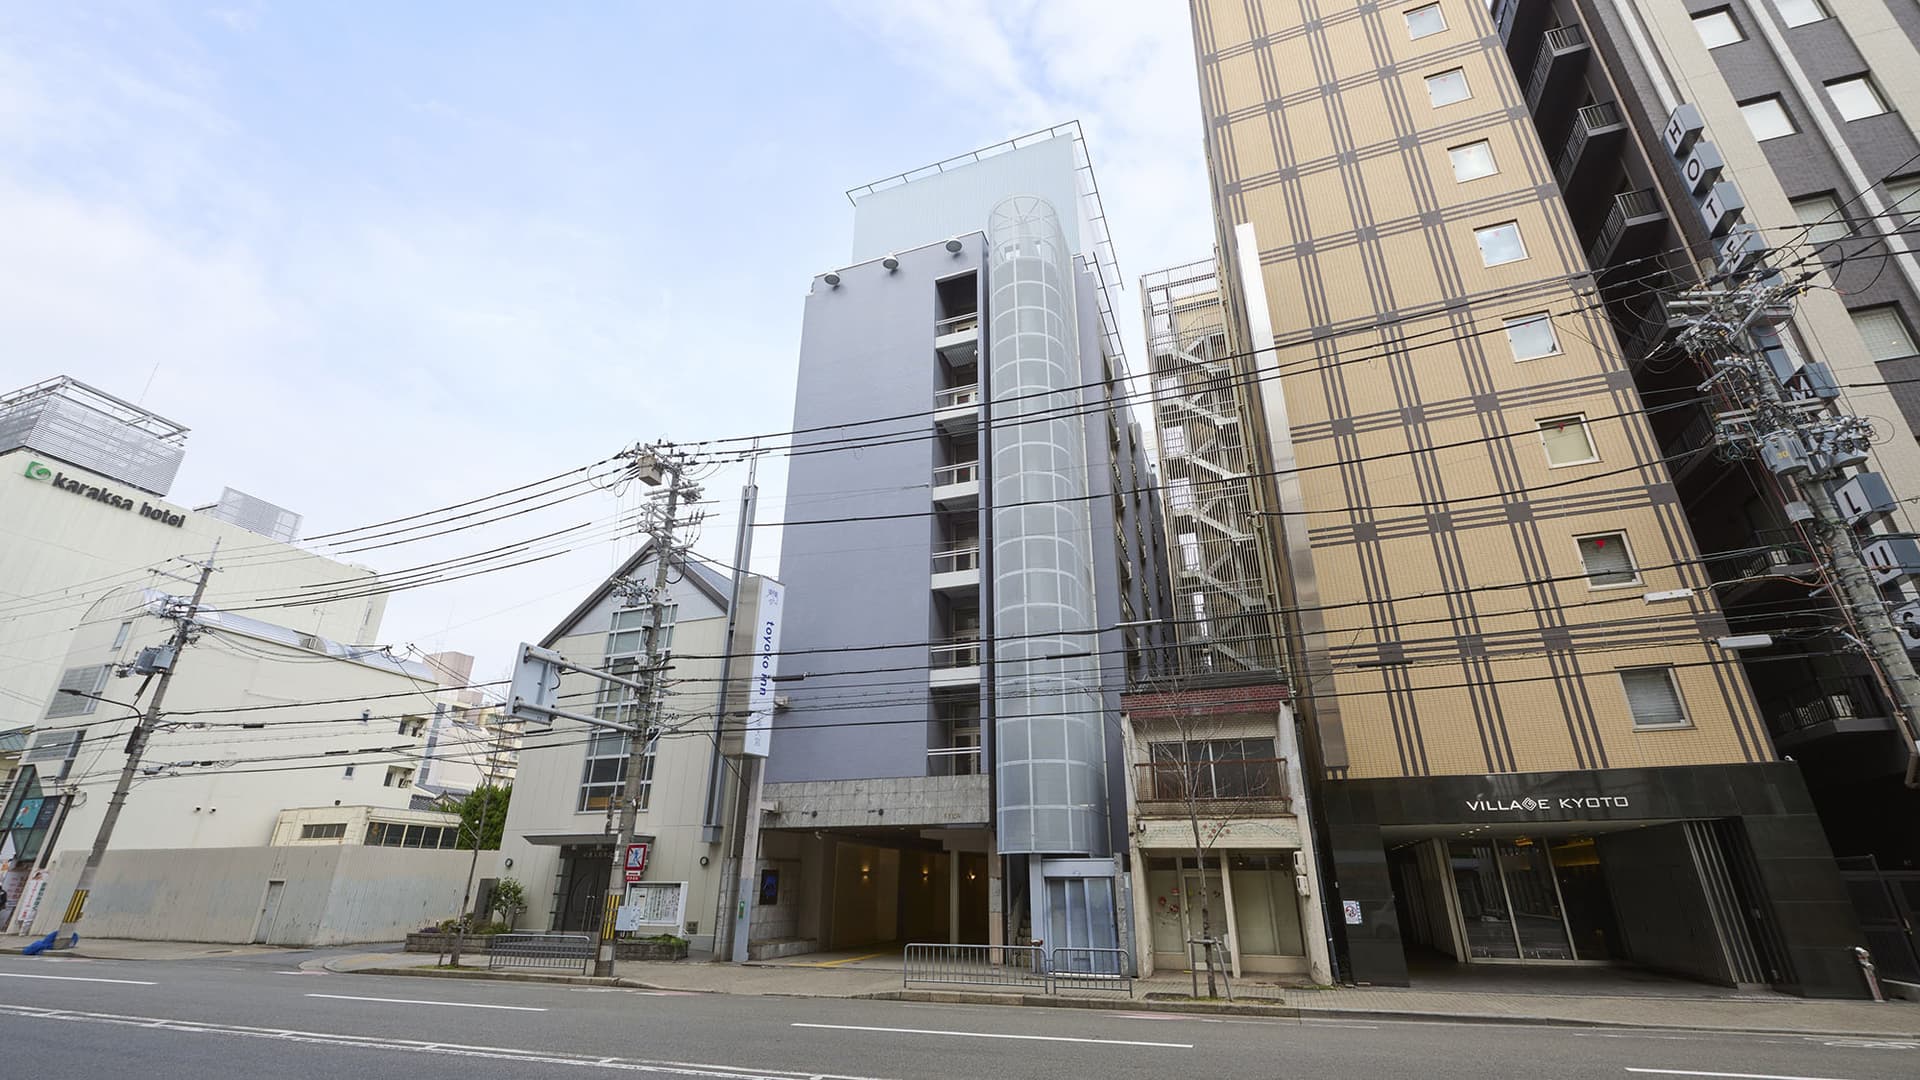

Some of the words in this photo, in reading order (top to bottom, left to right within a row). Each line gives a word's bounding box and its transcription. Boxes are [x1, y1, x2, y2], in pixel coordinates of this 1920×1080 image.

[52, 472, 134, 511] karaksa
[139, 502, 186, 528] hotel
[762, 621, 775, 669] toyoko
[760, 673, 769, 696] inn
[1466, 797, 1550, 812] VILLAGE
[1559, 796, 1629, 809] KYOTO
